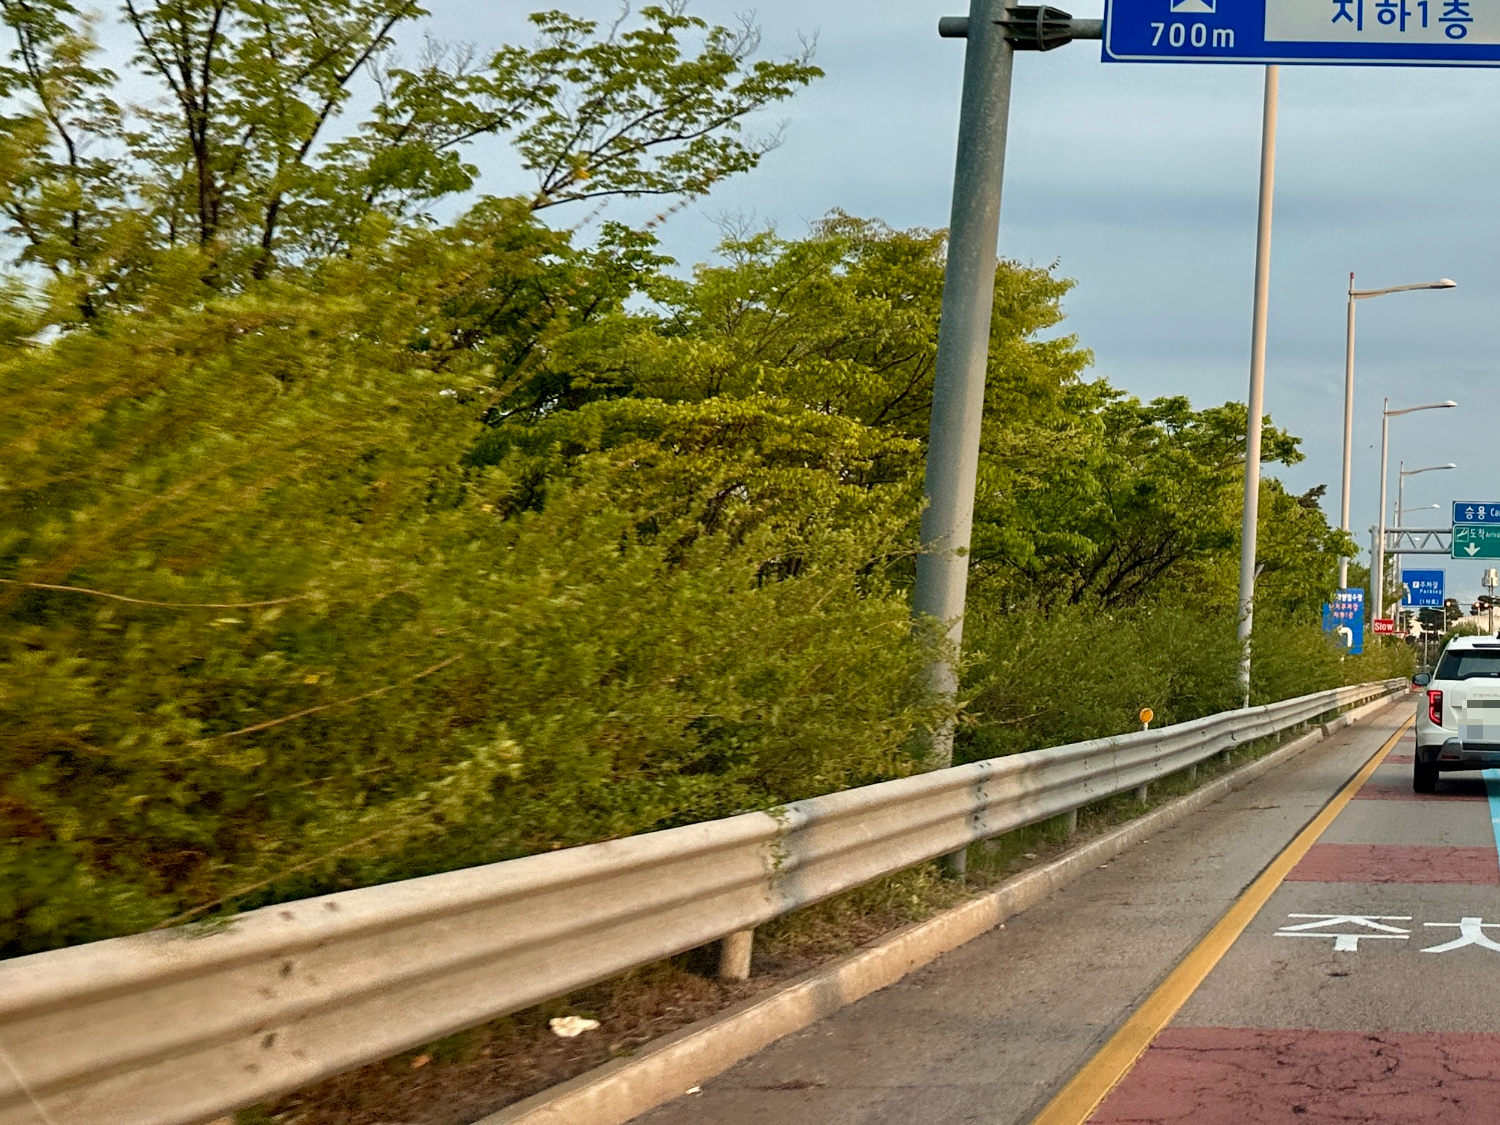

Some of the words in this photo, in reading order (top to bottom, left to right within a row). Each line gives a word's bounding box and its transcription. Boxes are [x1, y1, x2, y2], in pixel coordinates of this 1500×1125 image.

[1150, 22, 1236, 49] 700m
[1464, 505, 1487, 520] 승용
[1469, 528, 1486, 540] 도착
[1374, 621, 1394, 631] Slow
